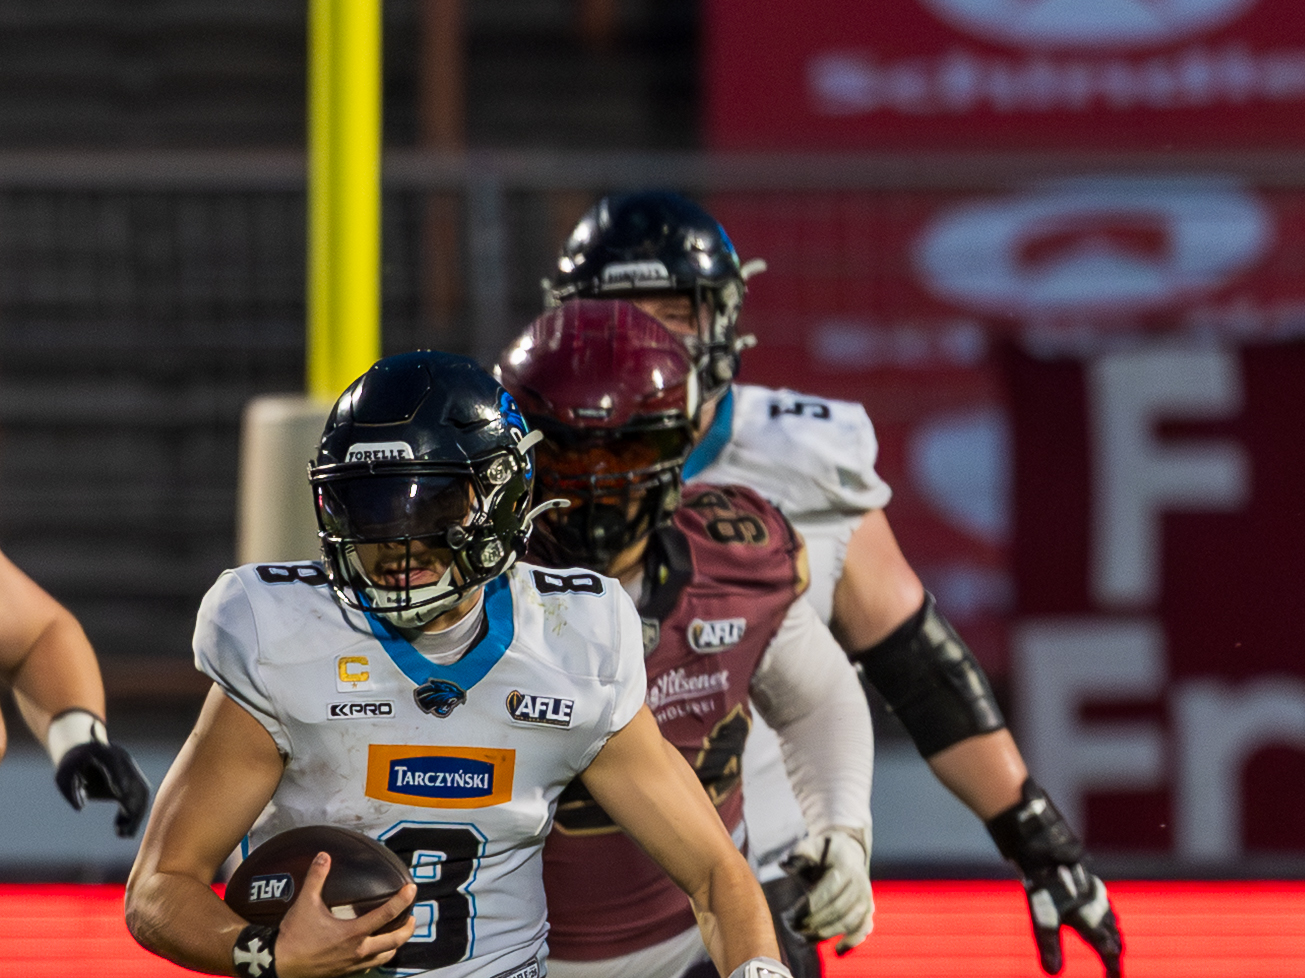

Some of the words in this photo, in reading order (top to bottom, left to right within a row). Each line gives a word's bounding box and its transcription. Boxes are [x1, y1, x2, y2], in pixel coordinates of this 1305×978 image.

[348, 449, 407, 461] FORELLE
[253, 564, 329, 586] 8
[530, 569, 607, 598] 8
[338, 655, 370, 682] C
[515, 694, 573, 722] AFLE
[249, 877, 288, 900] AFLE
[377, 819, 489, 977] 8
